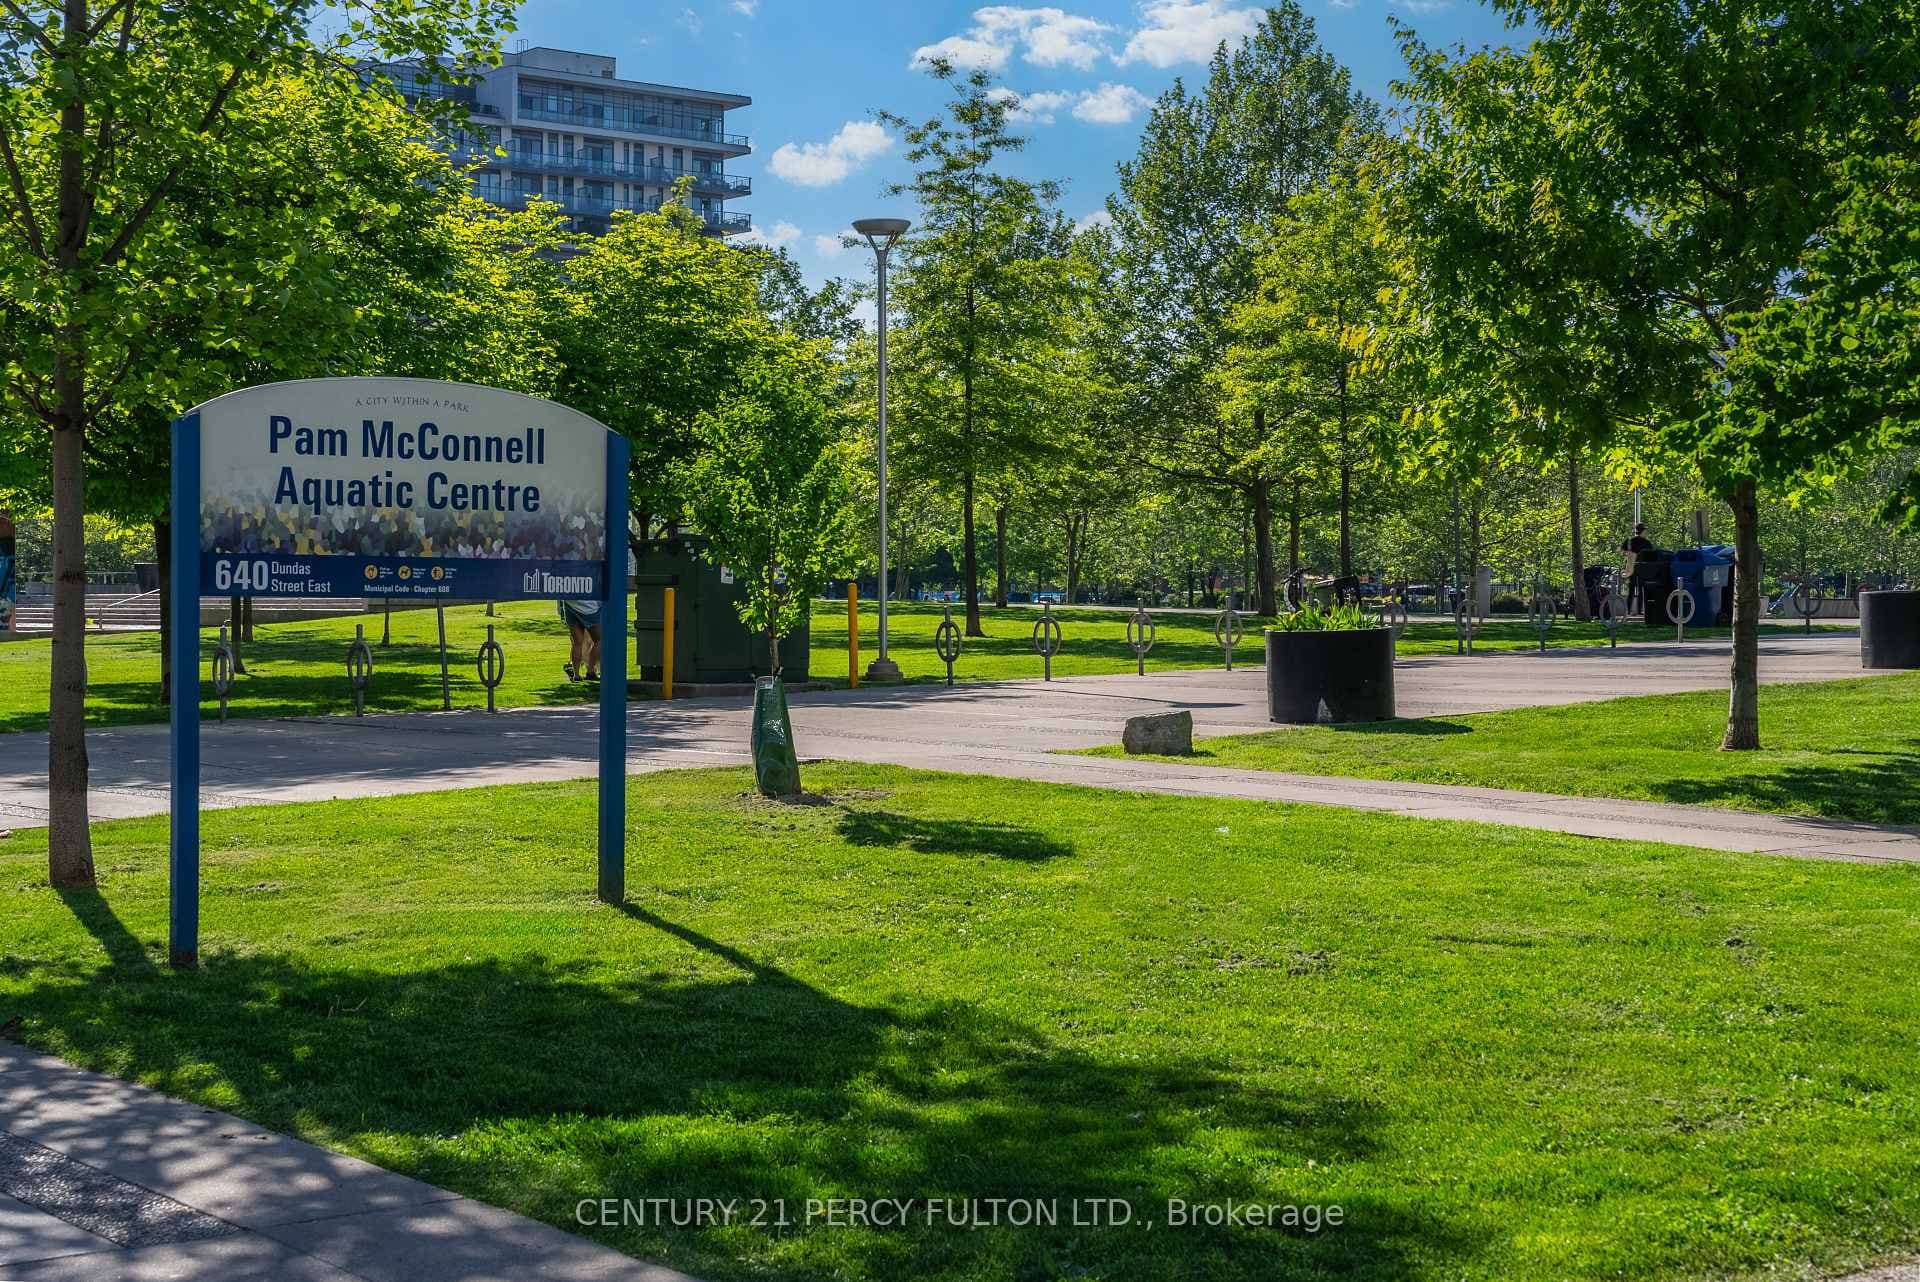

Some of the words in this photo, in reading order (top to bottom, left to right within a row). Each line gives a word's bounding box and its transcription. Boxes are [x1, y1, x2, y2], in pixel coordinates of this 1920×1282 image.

[366, 396, 387, 405] CITY
[393, 395, 429, 406] WITHIN
[433, 400, 439, 408] A
[444, 400, 469, 413] PARK
[270, 415, 348, 457] Pam
[362, 419, 545, 465] McConnell
[274, 466, 414, 516] Aquatic
[427, 471, 540, 513] Centre
[215, 560, 269, 591] 640
[271, 561, 311, 575] Dundas
[271, 579, 304, 592] Street
[308, 579, 331, 593] East
[364, 584, 394, 593] Municipal
[394, 585, 410, 593] Code
[413, 585, 437, 595] Chapter
